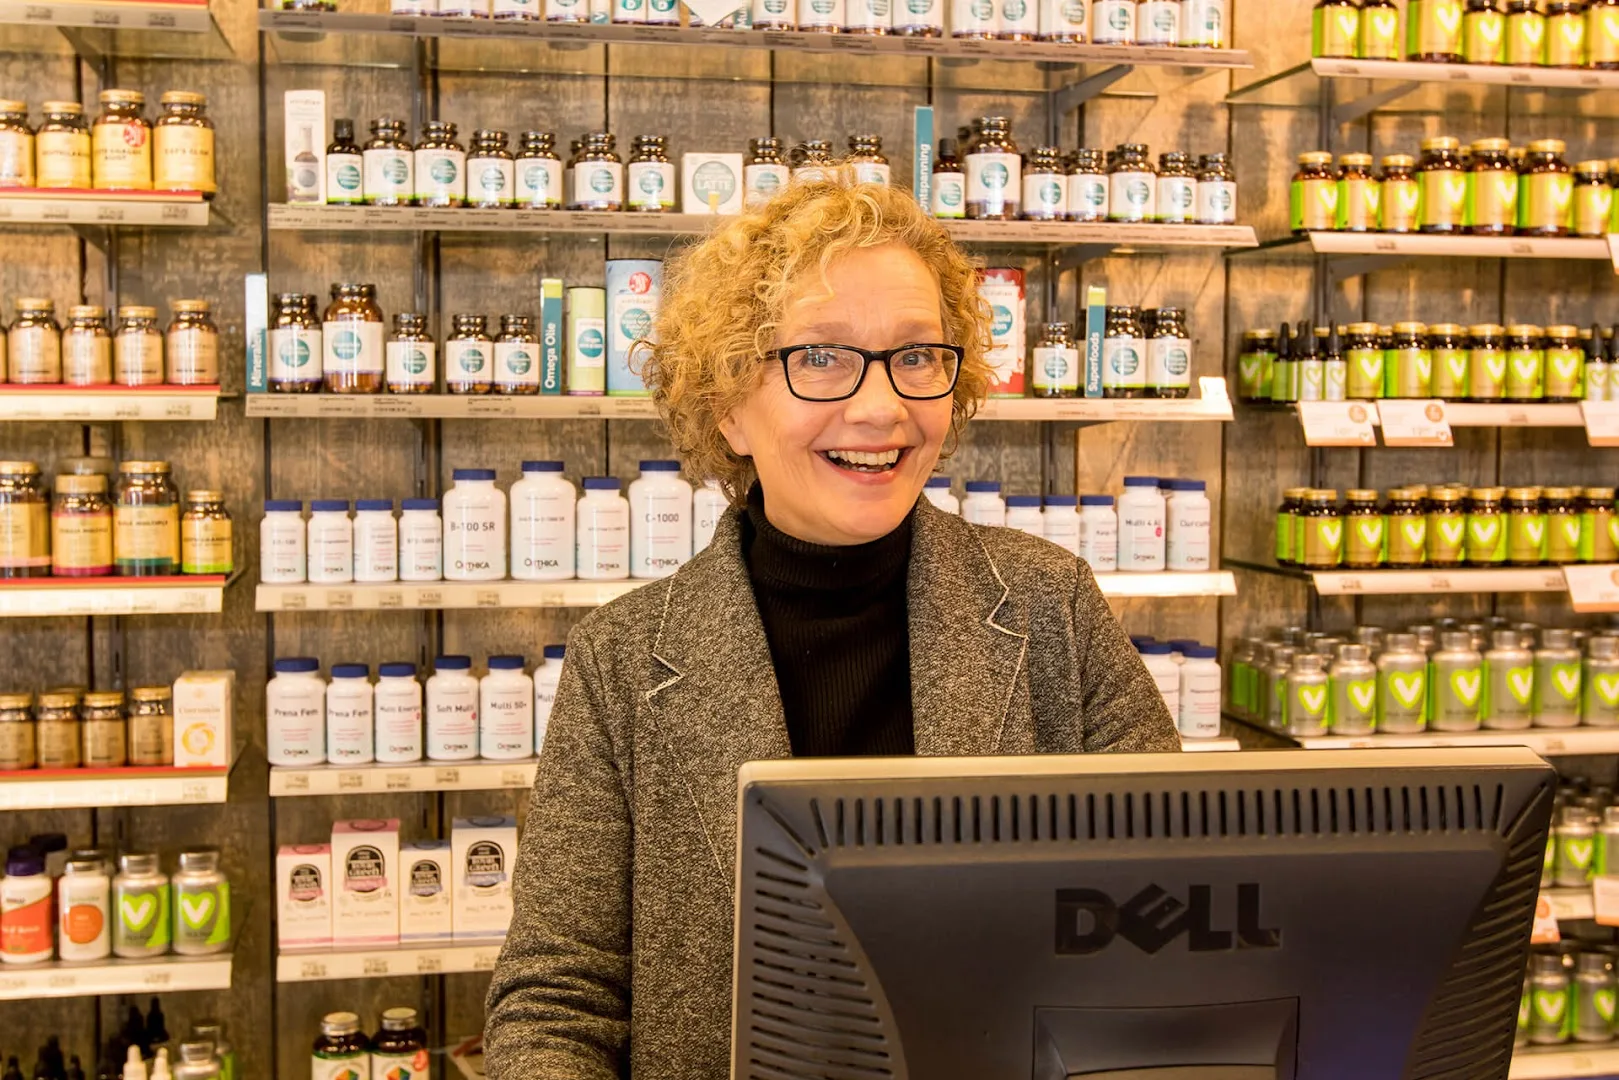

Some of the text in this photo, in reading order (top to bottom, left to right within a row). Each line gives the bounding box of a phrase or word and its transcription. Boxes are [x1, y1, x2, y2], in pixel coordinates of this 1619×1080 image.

[544, 322, 558, 389] Omega Olie
[1088, 331, 1100, 393] Superfoods
[645, 513, 680, 523] C-1000
[450, 521, 496, 532] B-100 SR
[537, 694, 555, 703] Mult
[436, 703, 452, 713] Soft
[490, 701, 512, 710] Multi
[300, 707, 319, 716] Fem
[352, 708, 369, 718] Fem
[1055, 882, 1281, 956] DELL
